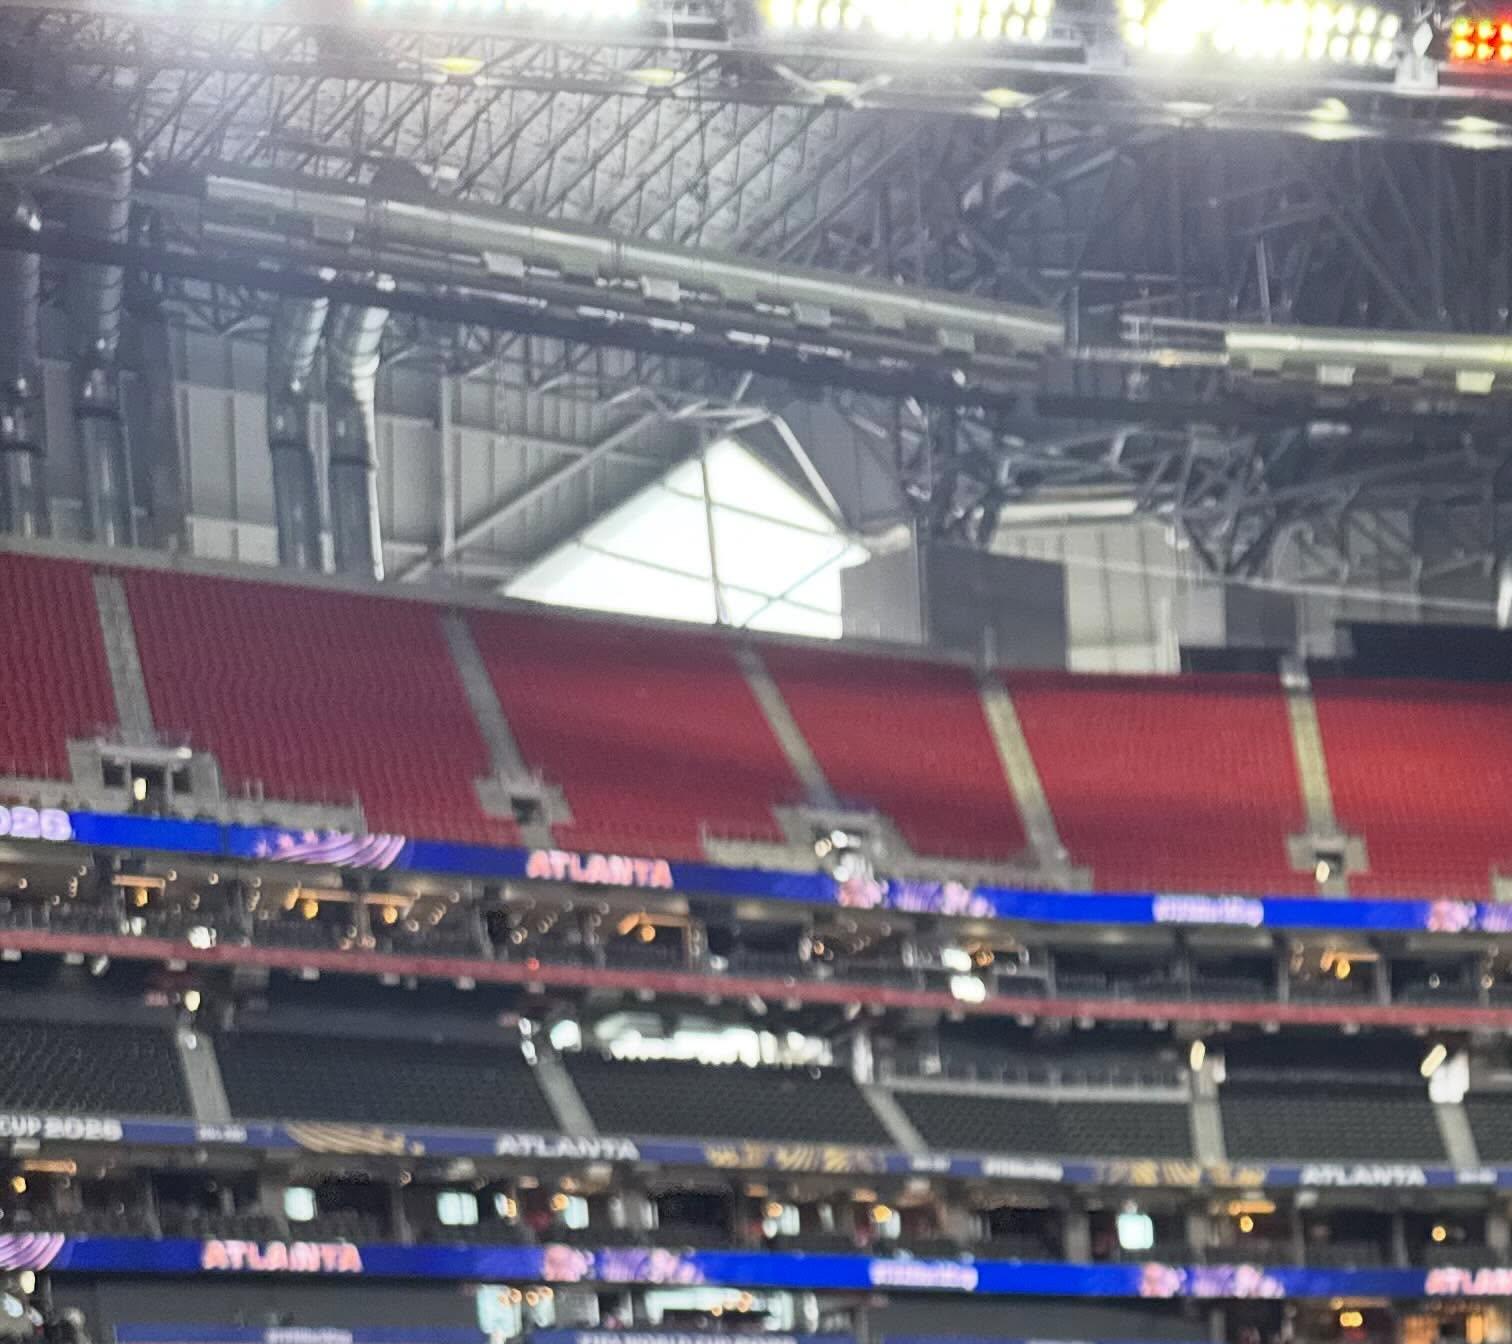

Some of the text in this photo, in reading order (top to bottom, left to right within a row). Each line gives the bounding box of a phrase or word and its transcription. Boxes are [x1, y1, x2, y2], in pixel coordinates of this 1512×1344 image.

[526, 850, 674, 889] ATLANTA
[496, 1133, 641, 1161] ATLANTA
[1301, 1163, 1427, 1187] ATLANTA
[202, 1239, 363, 1273] ATLANTA
